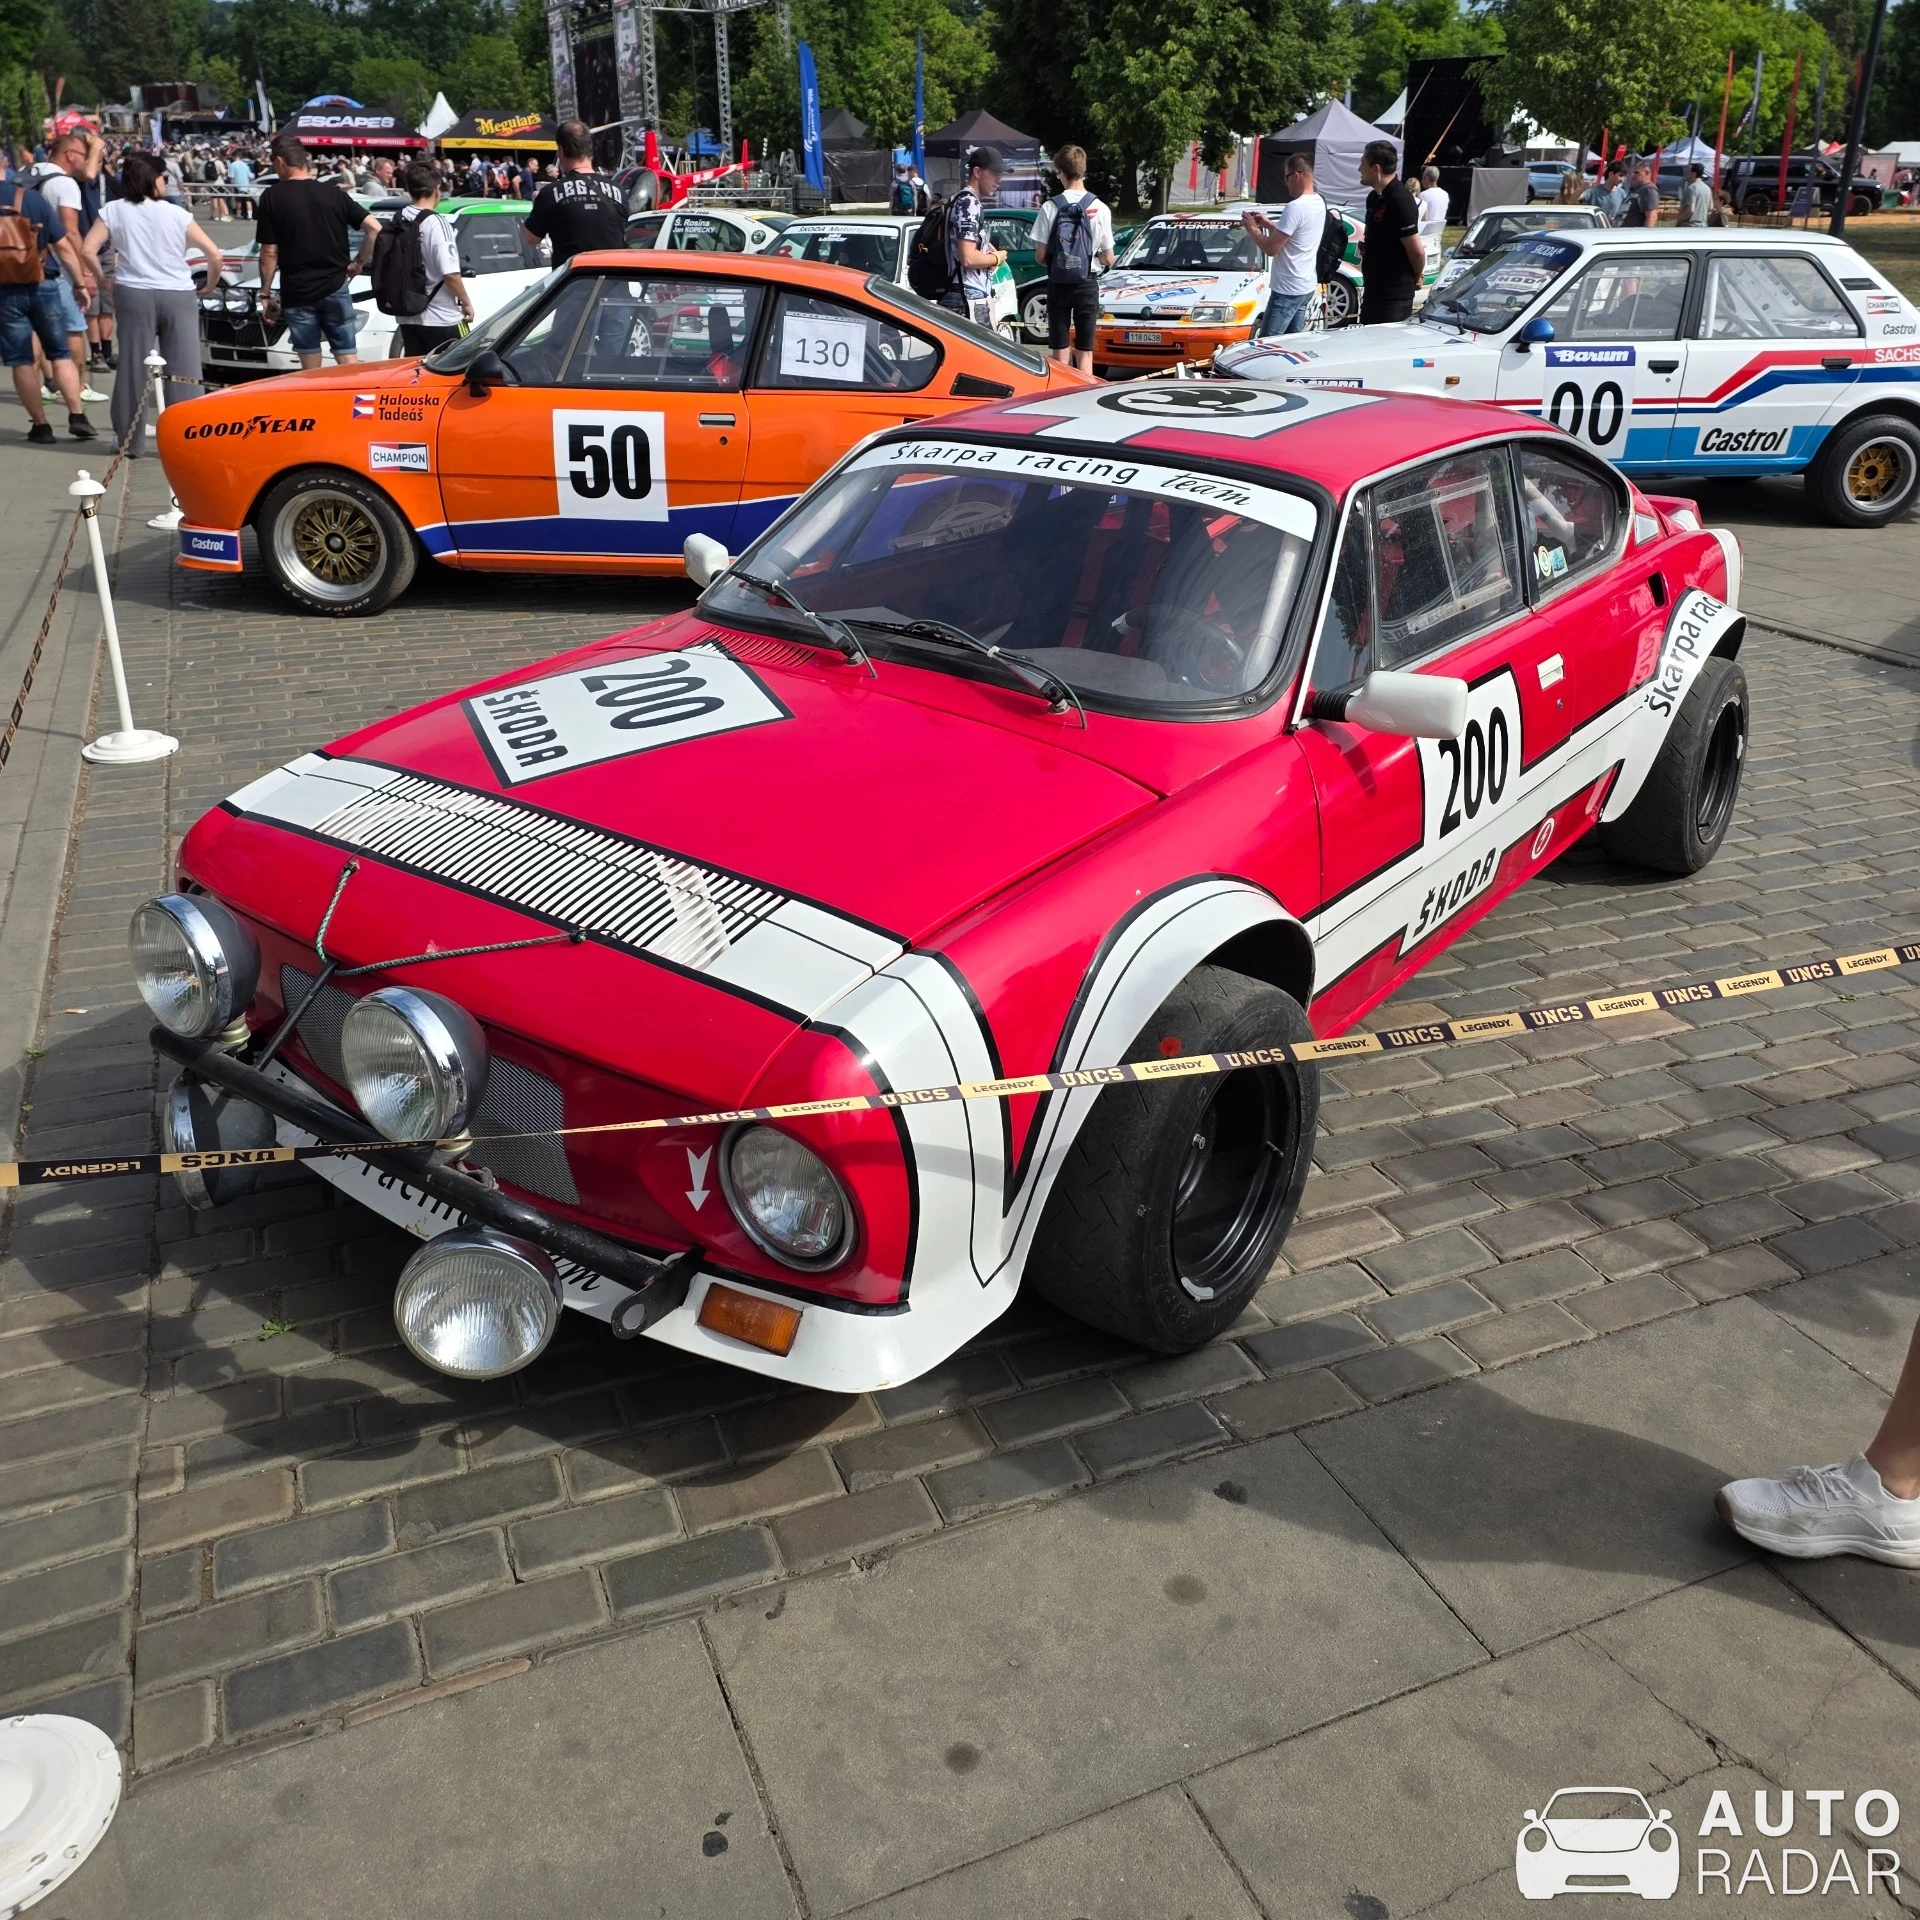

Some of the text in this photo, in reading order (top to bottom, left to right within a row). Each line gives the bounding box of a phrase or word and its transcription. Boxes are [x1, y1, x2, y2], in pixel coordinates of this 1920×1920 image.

[1867, 301, 1899, 309] CHAMPION
[1883, 324, 1916, 335] Castrol
[795, 338, 849, 368] 130
[1555, 349, 1629, 362] Barum
[379, 393, 439, 406] Halouska
[378, 407, 423, 421] Tadeáš
[1549, 381, 1623, 446] 00
[1701, 428, 1789, 453] Castrol
[373, 452, 425, 463] CHAMPION
[568, 424, 651, 499] 50
[1016, 455, 1140, 484] racing
[1160, 473, 1251, 505] team
[192, 537, 224, 551] Castrol
[580, 659, 724, 729] 200
[482, 689, 568, 767] ŠKODA
[1438, 707, 1508, 839] 200
[1412, 847, 1496, 938] ŠKODA
[680, 1109, 757, 1124] UNCS
[879, 1088, 950, 1105] UNCS
[1059, 1067, 1125, 1086] UNCS
[1224, 1047, 1286, 1067] UNCS
[1387, 1026, 1445, 1046] UNCS
[1530, 1005, 1584, 1026] UNCS
[1662, 984, 1713, 1004] UNCS
[1786, 962, 1834, 982] UNCS
[41, 1161, 140, 1177] LEGENDY
[181, 1151, 276, 1167] UNCS
